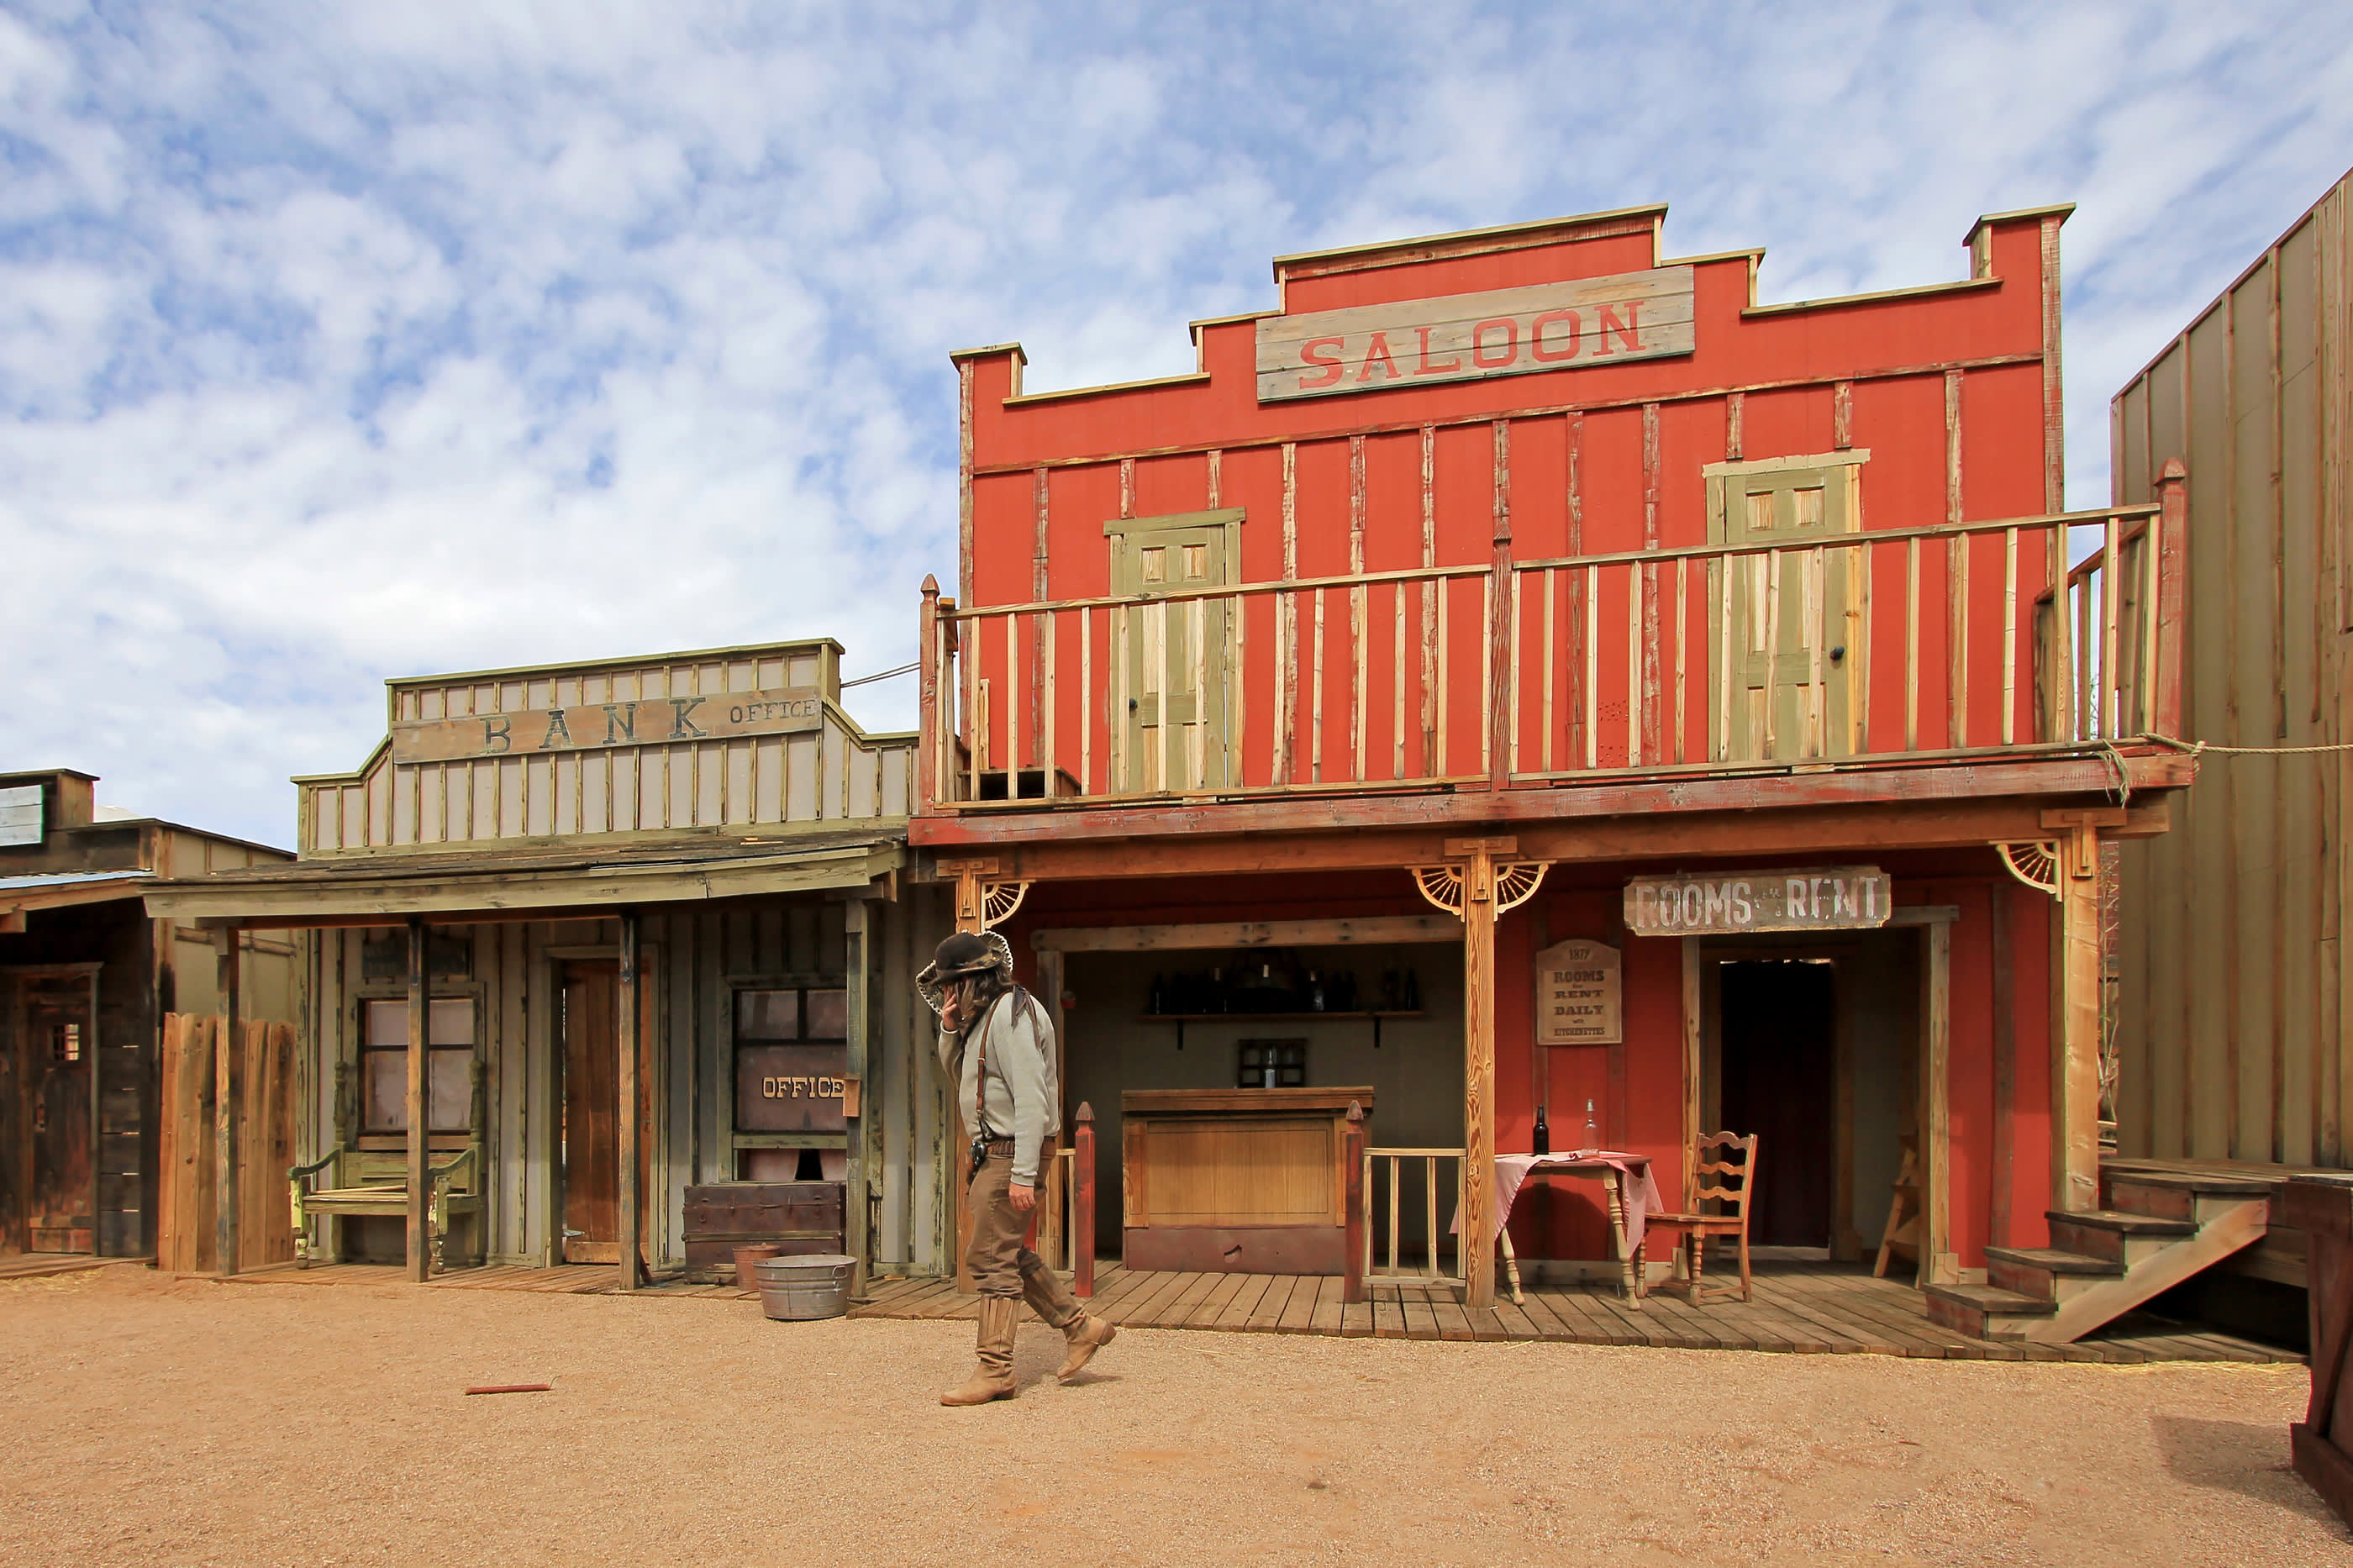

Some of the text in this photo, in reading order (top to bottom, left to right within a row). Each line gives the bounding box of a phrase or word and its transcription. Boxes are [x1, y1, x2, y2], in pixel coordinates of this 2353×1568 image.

[1298, 300, 1647, 389] SALOON
[479, 697, 815, 755] BANK OFFICE
[1636, 881, 1751, 929] ROOMS
[1553, 970, 1605, 983] ROOMS
[1554, 990, 1604, 999] RENT
[1554, 1005, 1604, 1015] DAILY
[762, 1076, 845, 1098] OFFICE
